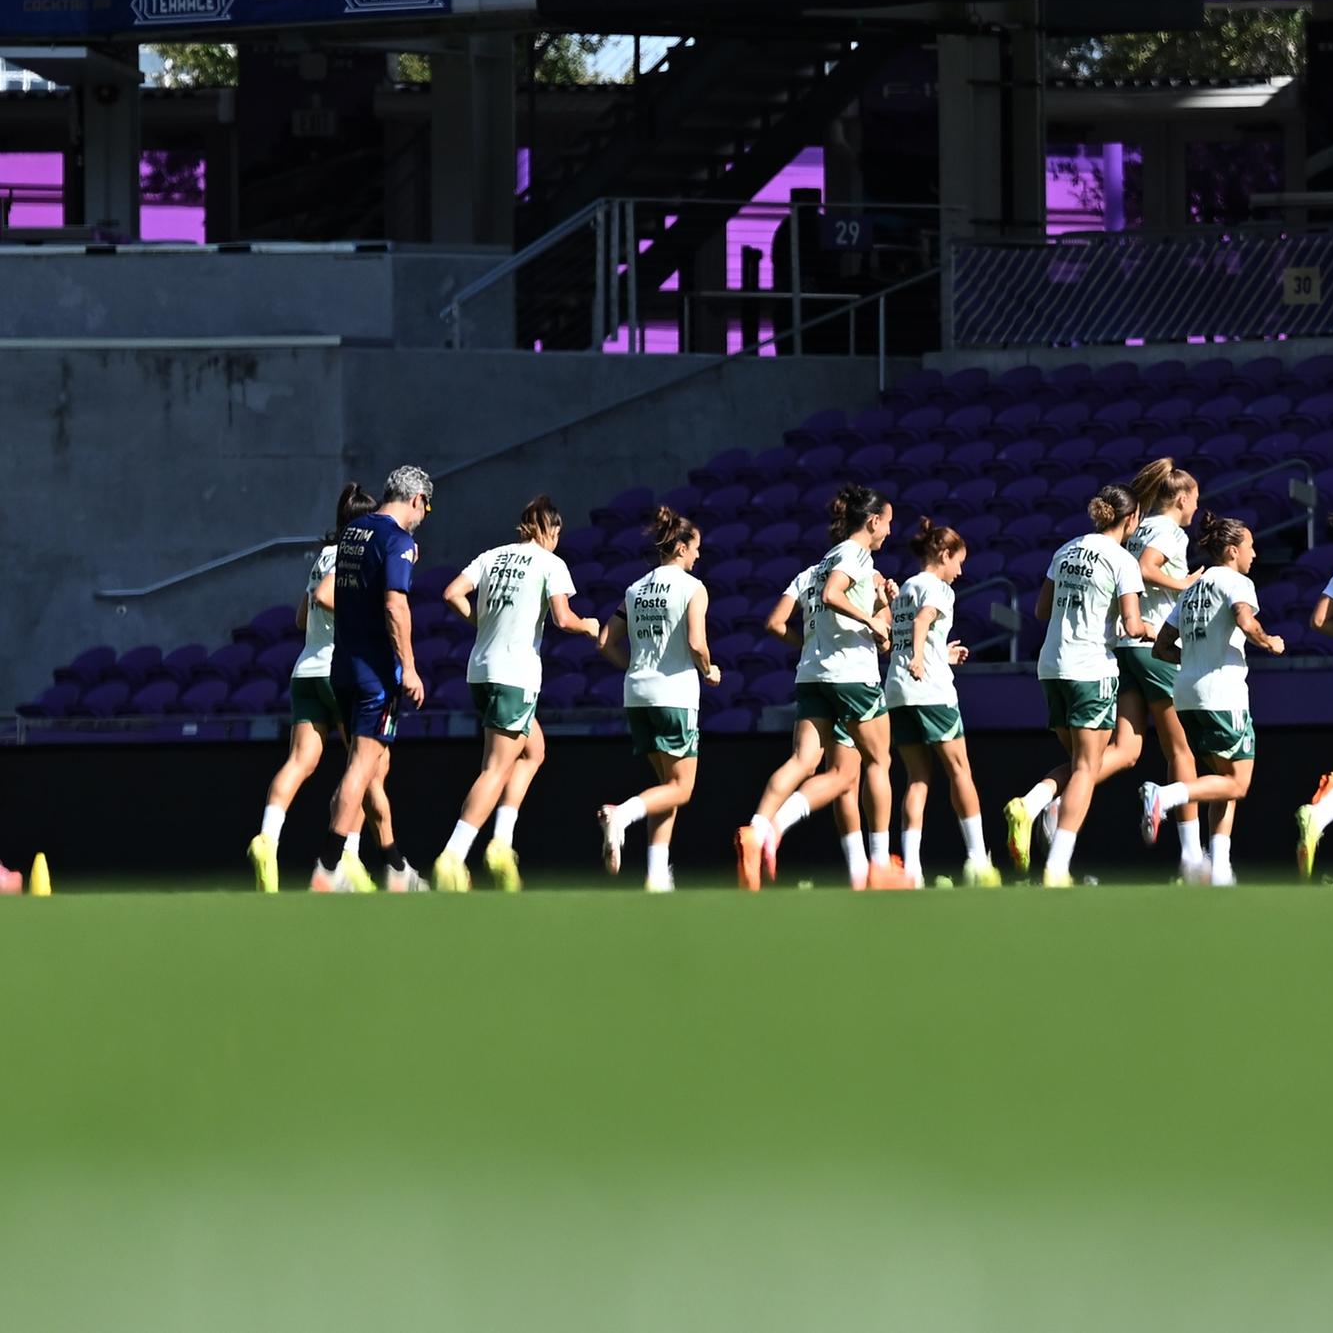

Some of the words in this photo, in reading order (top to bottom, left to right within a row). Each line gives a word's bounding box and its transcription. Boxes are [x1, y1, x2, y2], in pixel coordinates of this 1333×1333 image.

[836, 220, 860, 246] 29
[1295, 275, 1312, 295] 30
[354, 528, 374, 542] TIM
[339, 540, 365, 556] Poste
[1077, 547, 1100, 564] TIM
[508, 553, 533, 566] TIM
[490, 566, 526, 579] Poste
[1060, 560, 1094, 578] Poste
[650, 582, 671, 594] TIM
[634, 597, 667, 609] Poste
